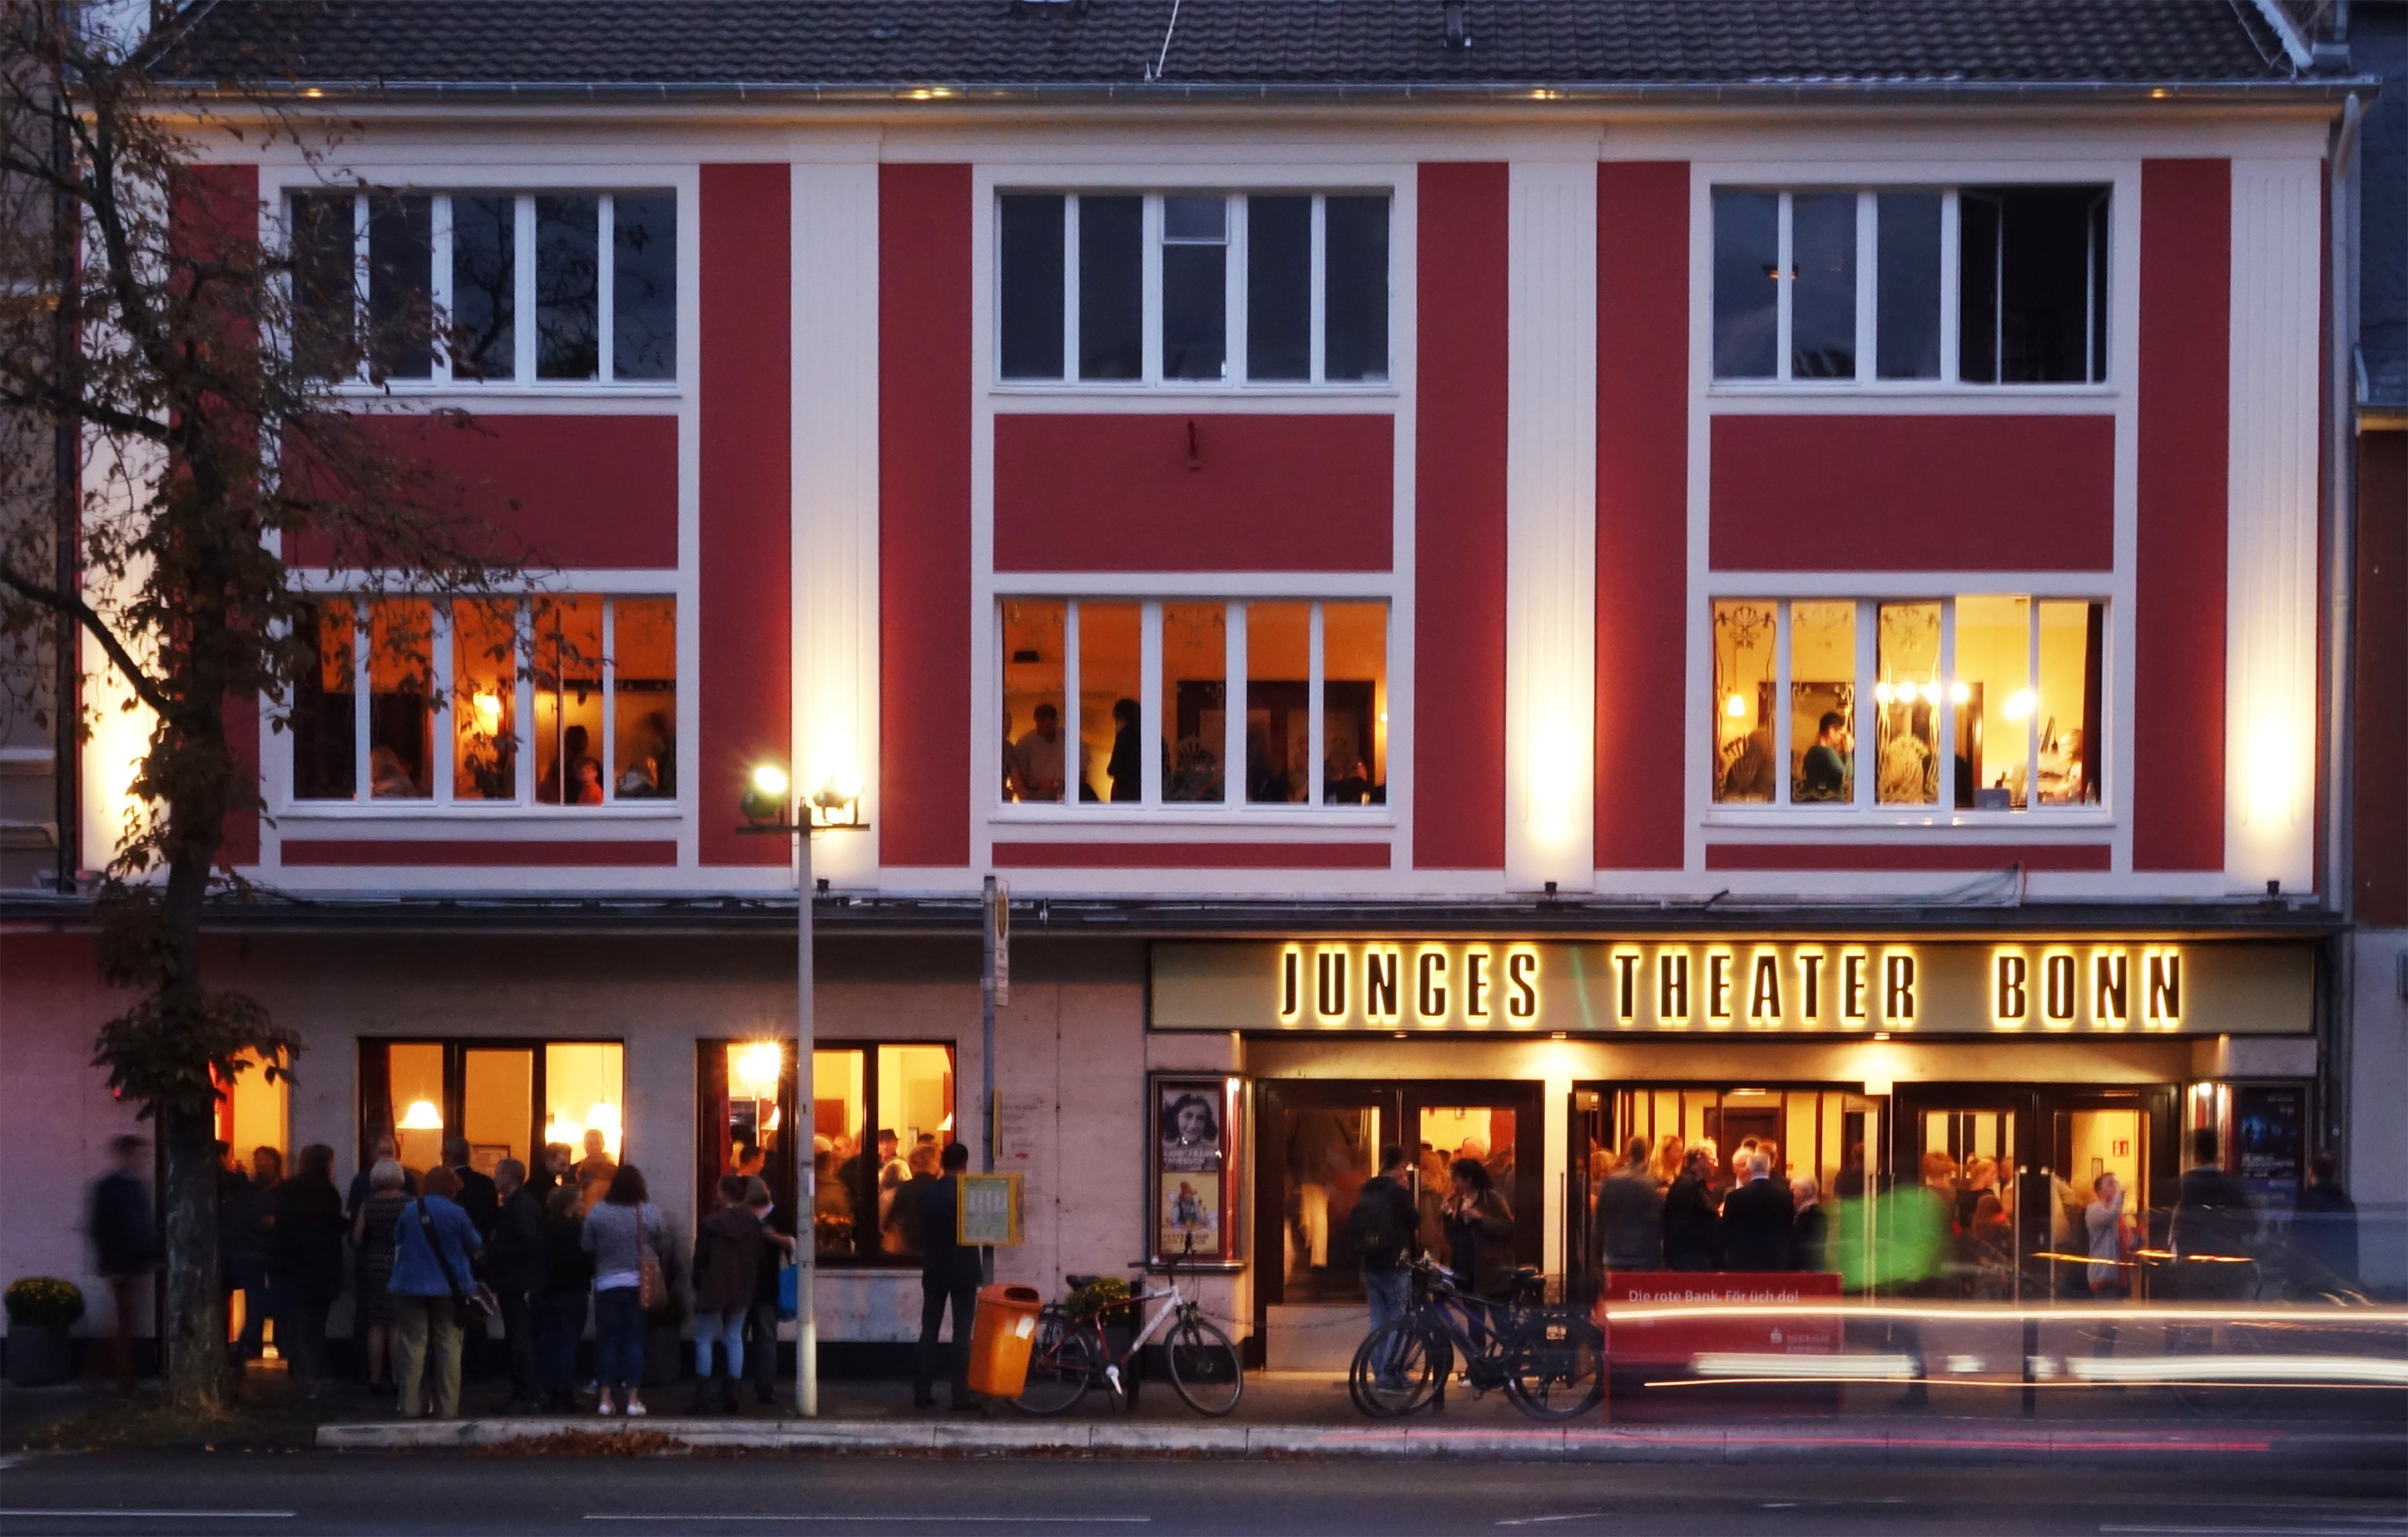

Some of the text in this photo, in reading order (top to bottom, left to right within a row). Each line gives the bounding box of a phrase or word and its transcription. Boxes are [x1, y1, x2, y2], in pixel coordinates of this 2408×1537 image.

[1281, 951, 2180, 1019] JUNGES THEATER BONN
[1628, 1289, 1651, 1302] Die
[1654, 1291, 1682, 1302] rote
[1684, 1289, 1722, 1303] Bank.
[1725, 1289, 1746, 1303] För
